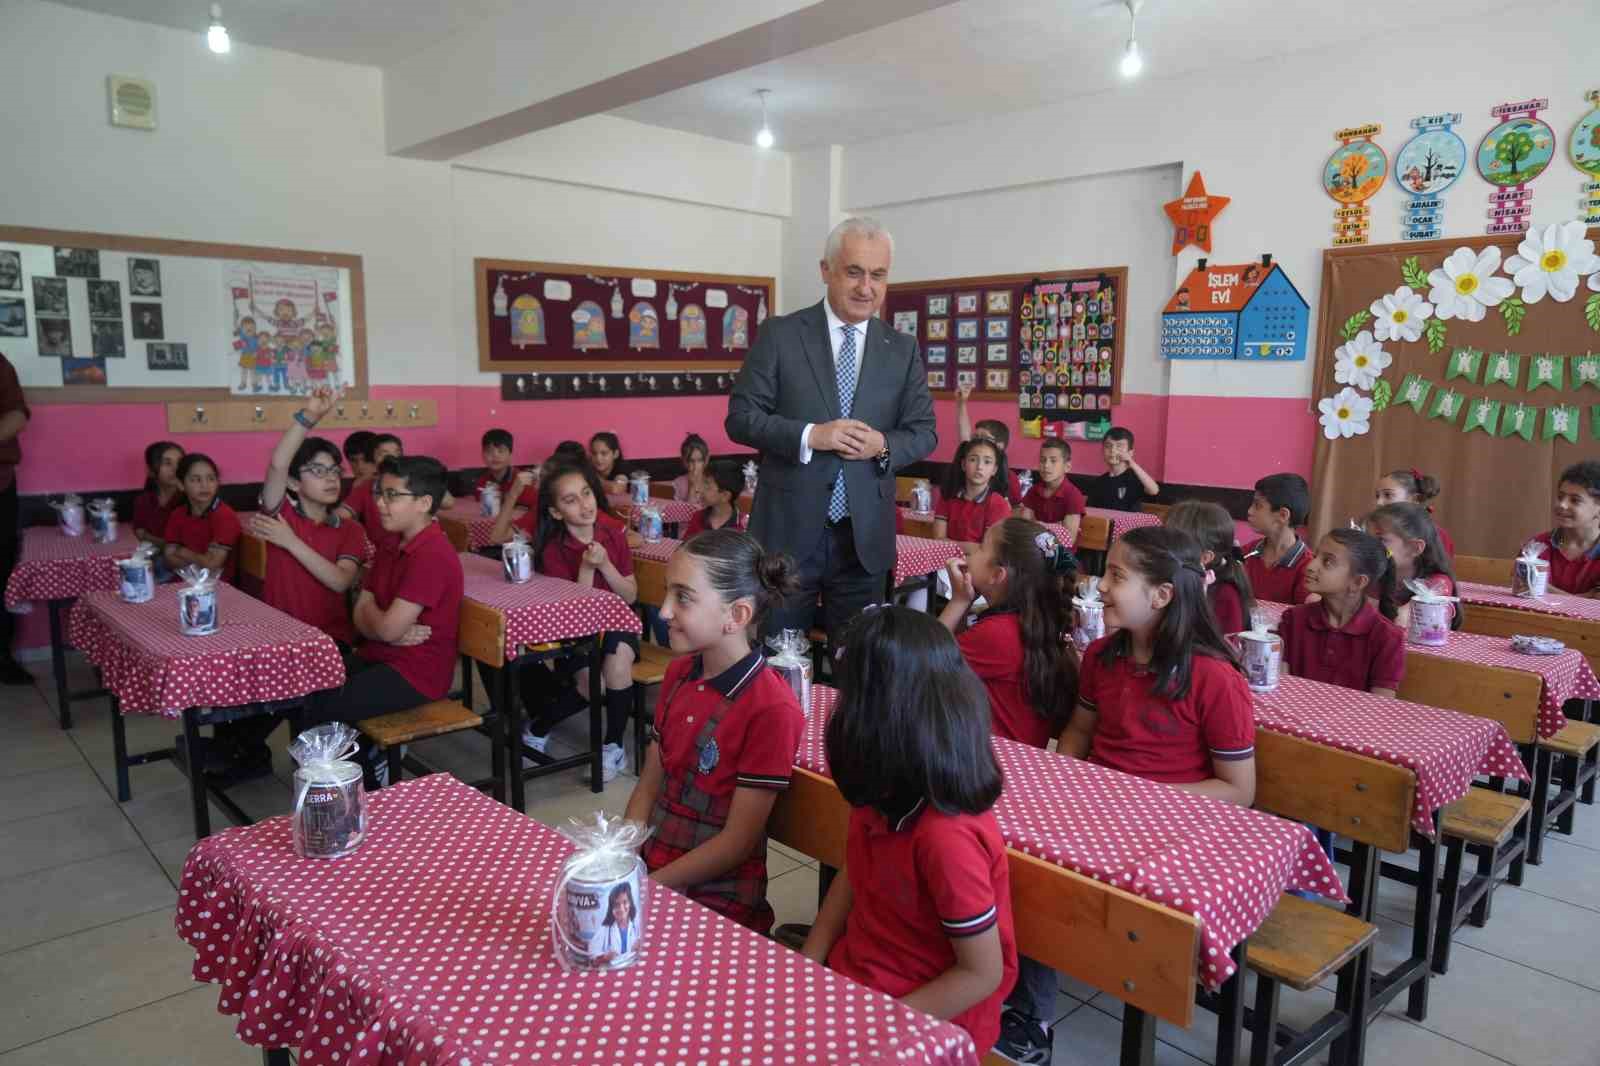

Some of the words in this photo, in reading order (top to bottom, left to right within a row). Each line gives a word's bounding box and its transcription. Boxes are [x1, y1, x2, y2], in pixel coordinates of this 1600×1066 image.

[1497, 192, 1525, 201] MART
[1412, 216, 1433, 224] OCAK
[1493, 223, 1523, 232] MAYIS
[1207, 272, 1239, 289] İŞLEM
[1211, 288, 1231, 304] EVİ
